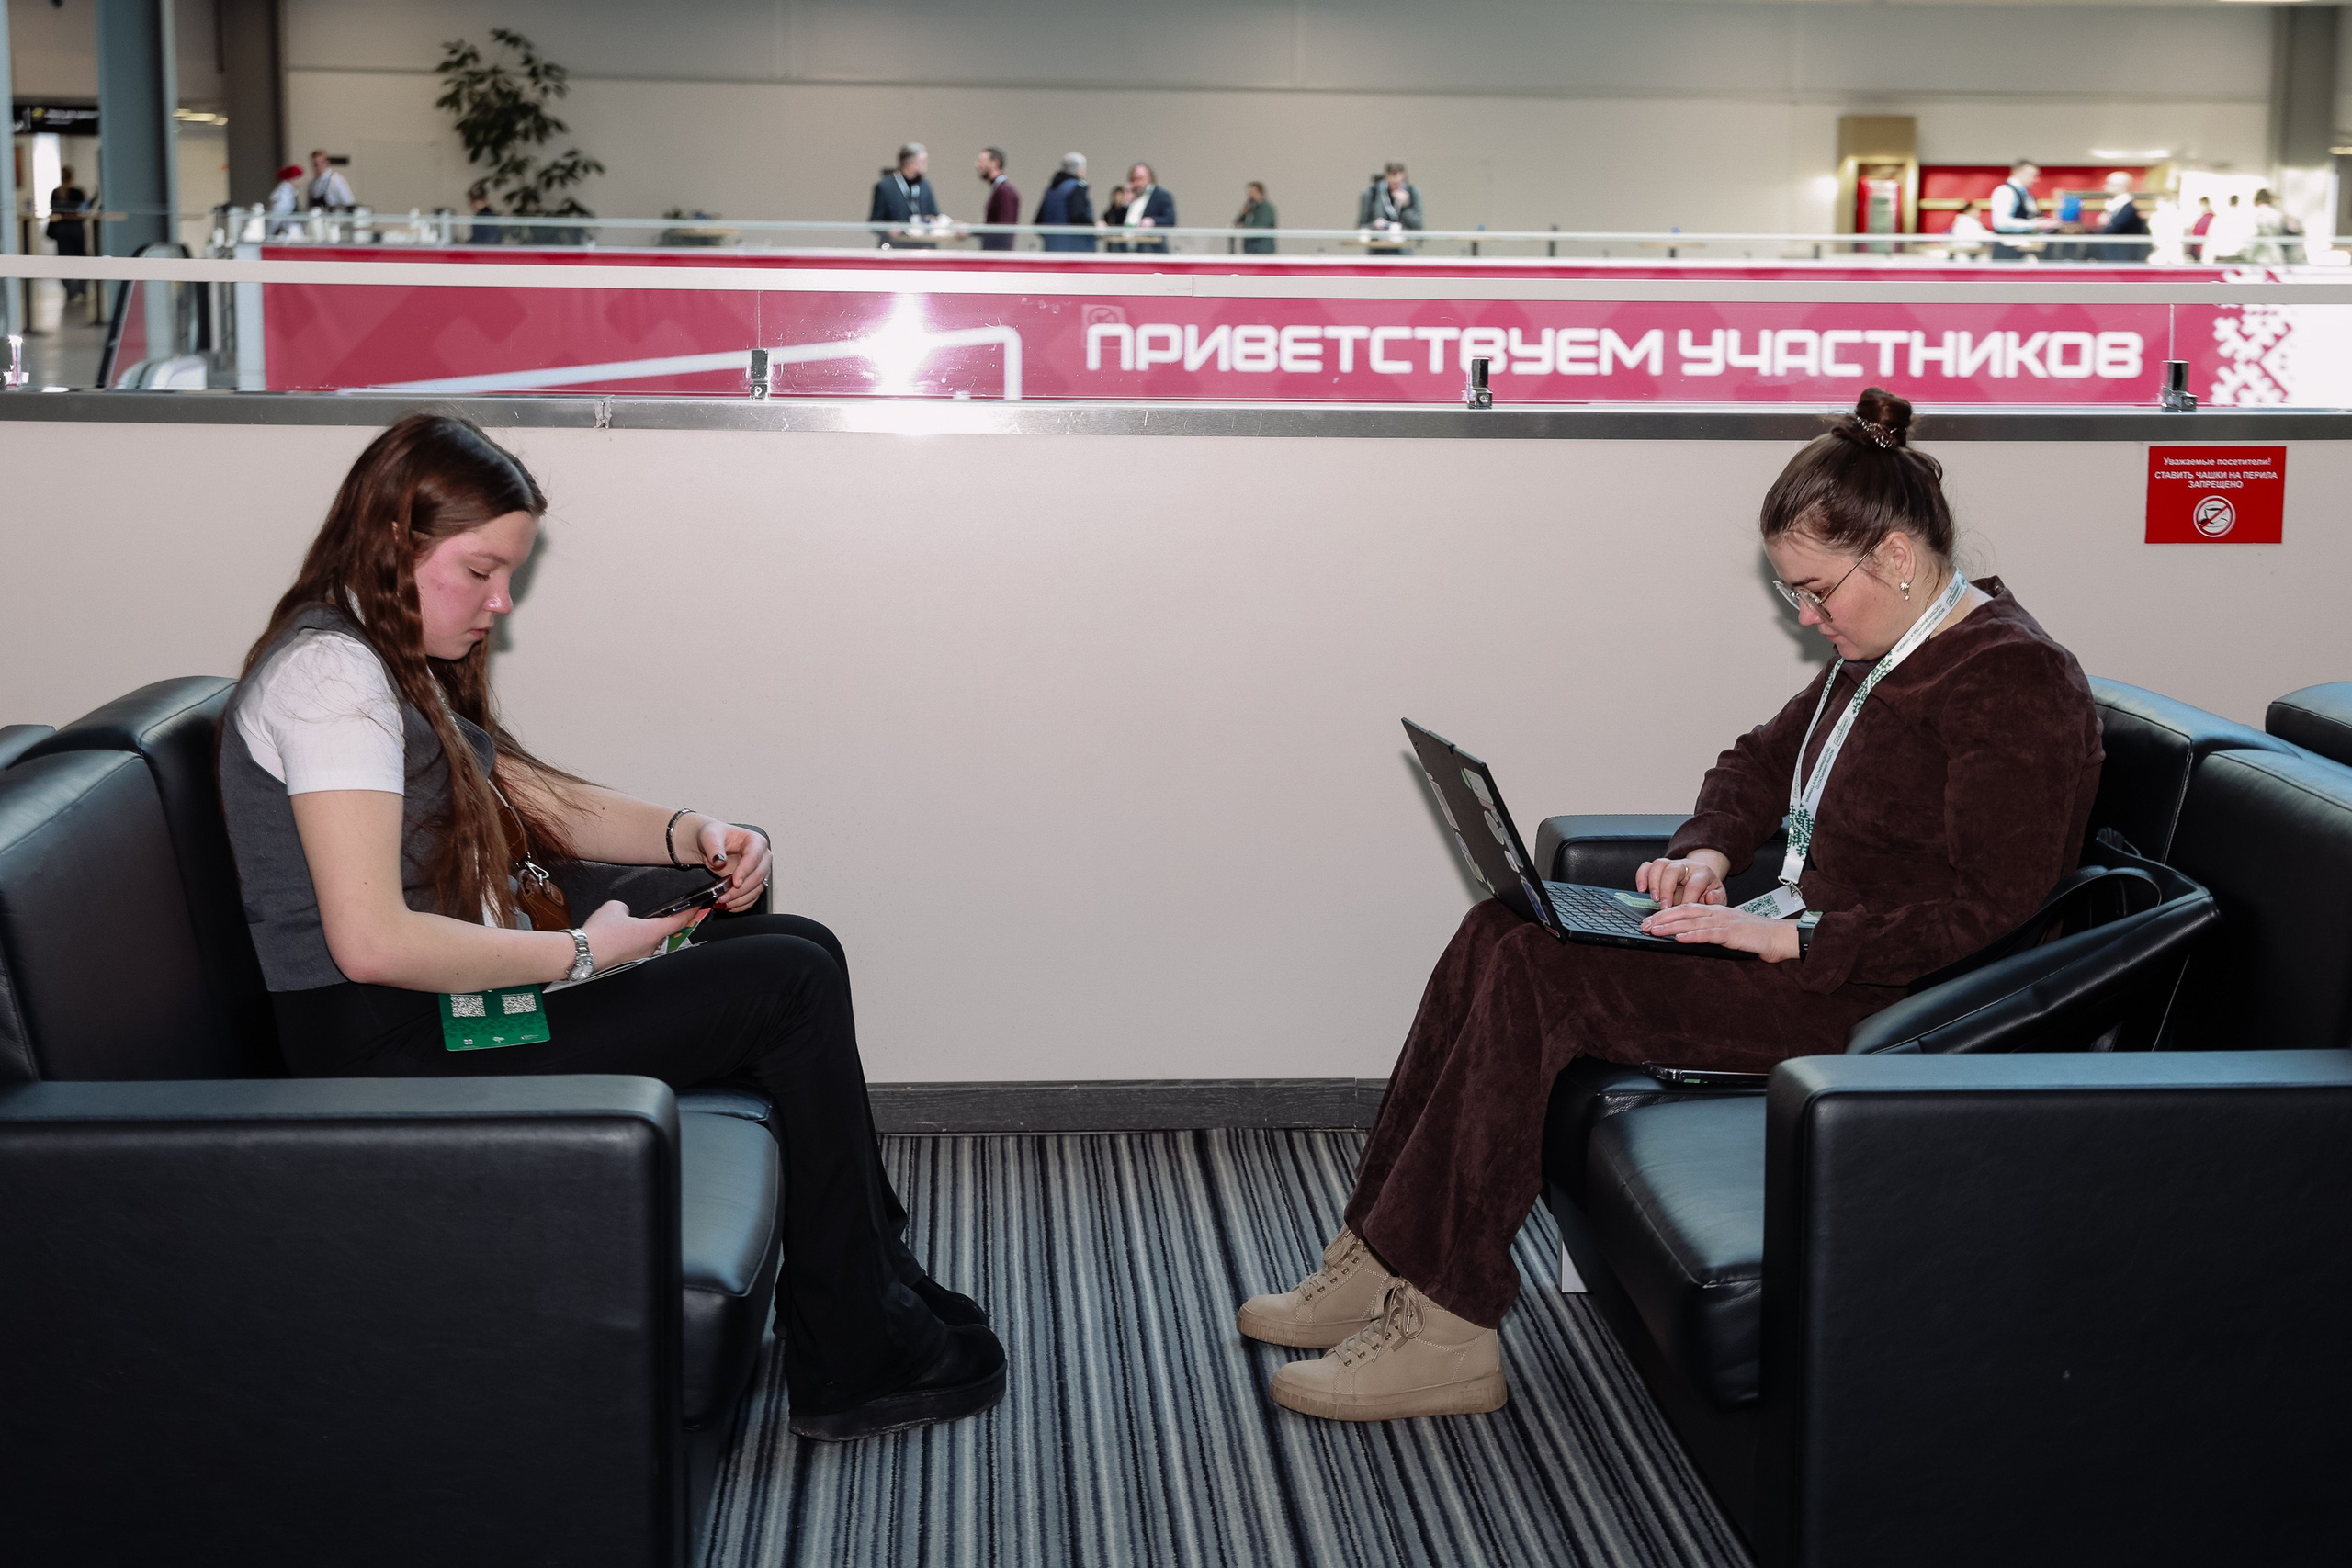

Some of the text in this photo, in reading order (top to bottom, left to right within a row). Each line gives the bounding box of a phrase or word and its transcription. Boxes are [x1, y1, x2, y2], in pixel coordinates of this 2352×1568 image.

[1085, 322, 2145, 379] ПРИВЕТСТВУЕМ УЧАСТНИКОВ
[2163, 457, 2272, 466] Уважаемые посетители!
[2188, 480, 2244, 489] ЗАПРЕЩЕНО
